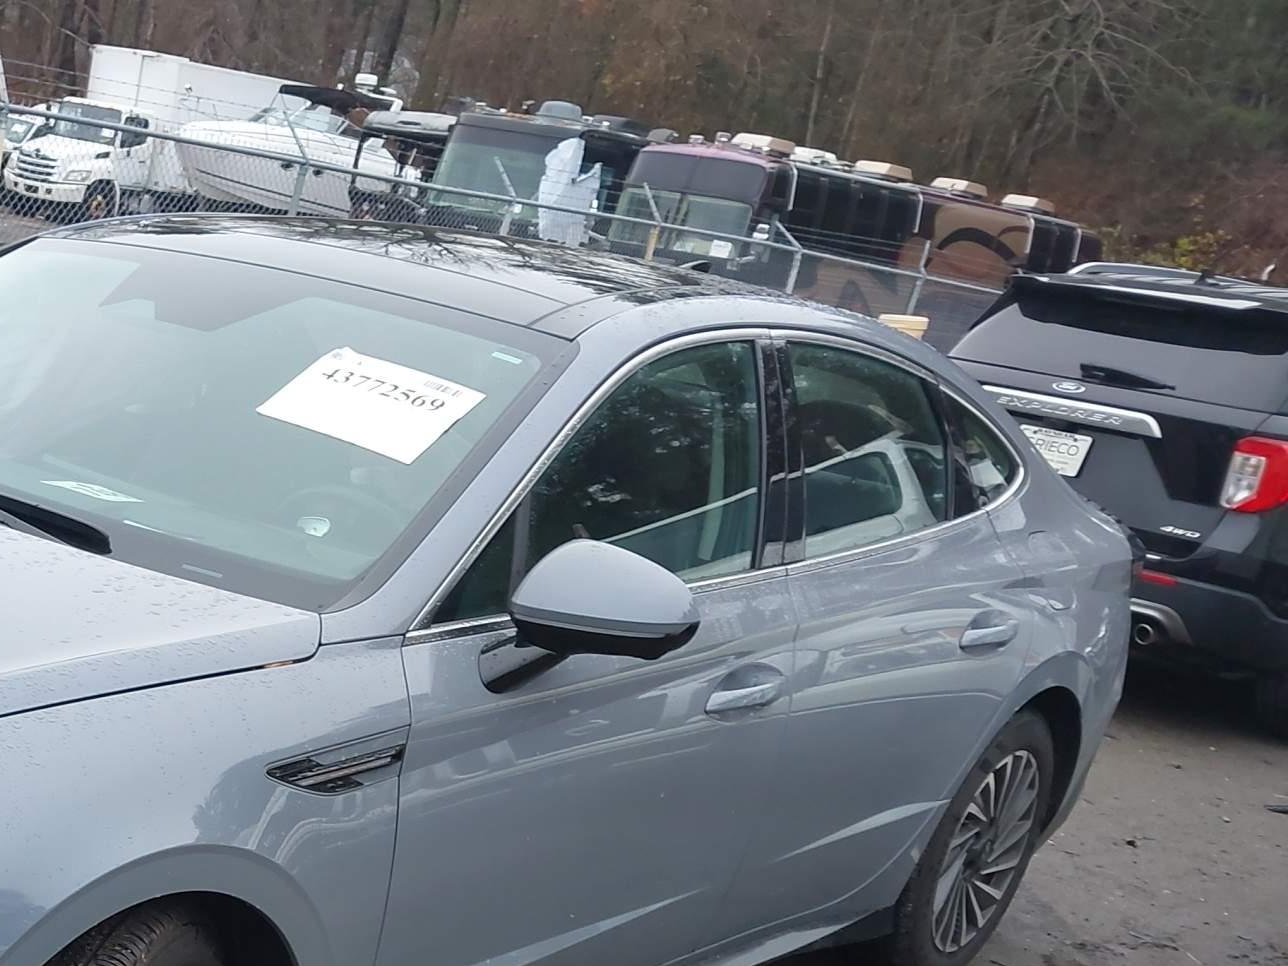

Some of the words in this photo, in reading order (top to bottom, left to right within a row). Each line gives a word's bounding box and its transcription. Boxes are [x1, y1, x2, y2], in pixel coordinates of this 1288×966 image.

[322, 368, 446, 412] 43772569
[996, 396, 1124, 426] EXPLORER
[1159, 525, 1201, 538] 4WD
